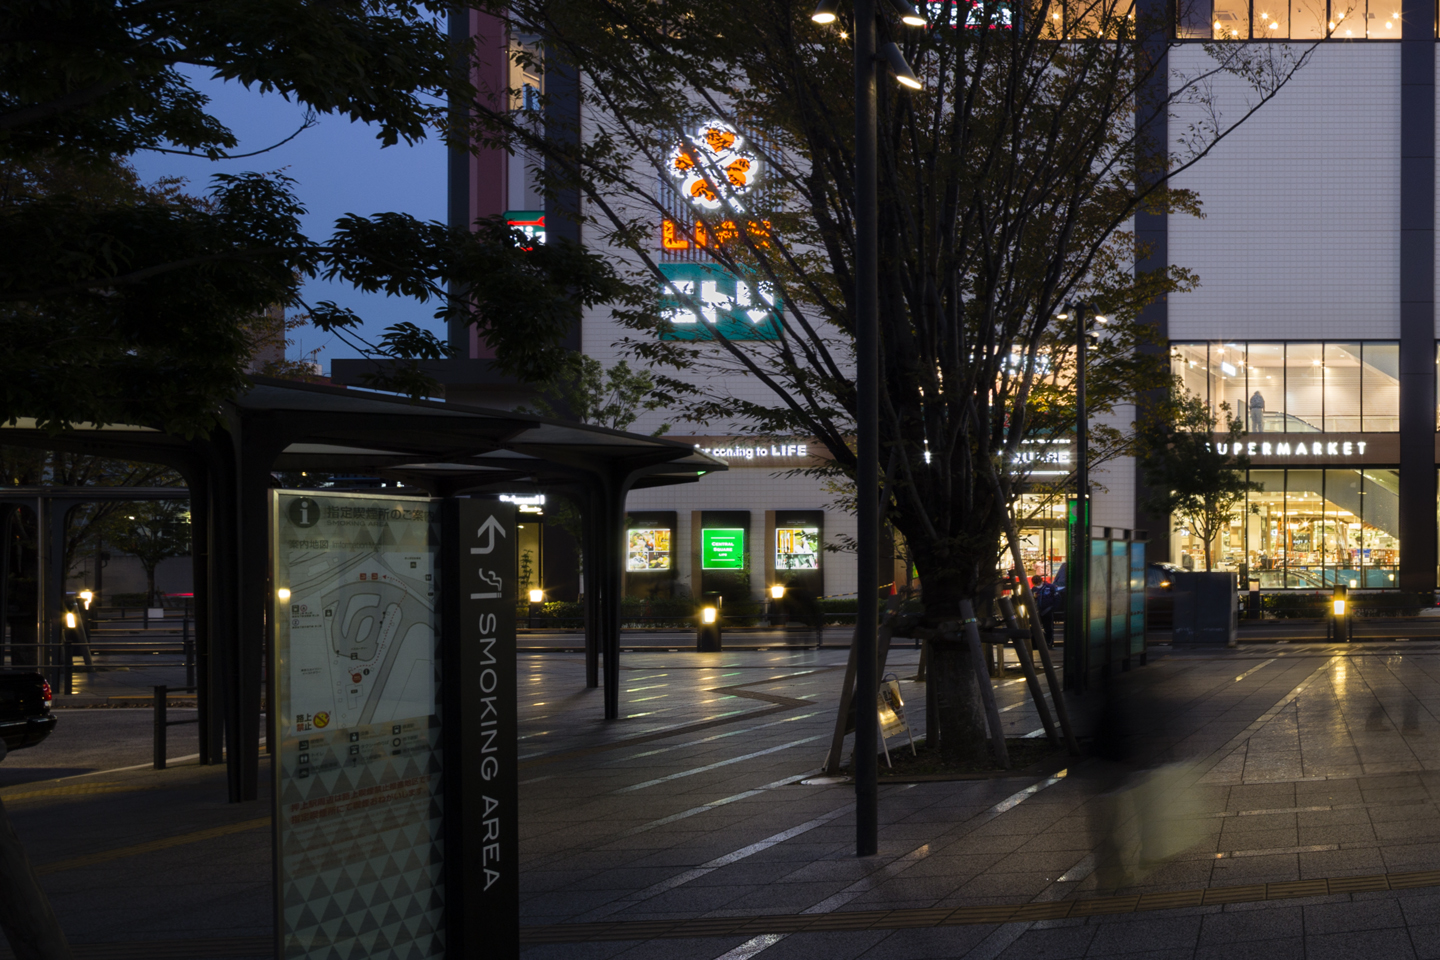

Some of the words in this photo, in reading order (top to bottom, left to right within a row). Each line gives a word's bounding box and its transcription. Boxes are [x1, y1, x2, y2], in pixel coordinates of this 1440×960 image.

[660, 280, 774, 323] ニトリ
[756, 446, 768, 456] to
[771, 444, 807, 456] LIFE
[326, 519, 366, 527] SMOKING
[479, 612, 499, 782] SMOKING
[482, 794, 500, 892] AREA
